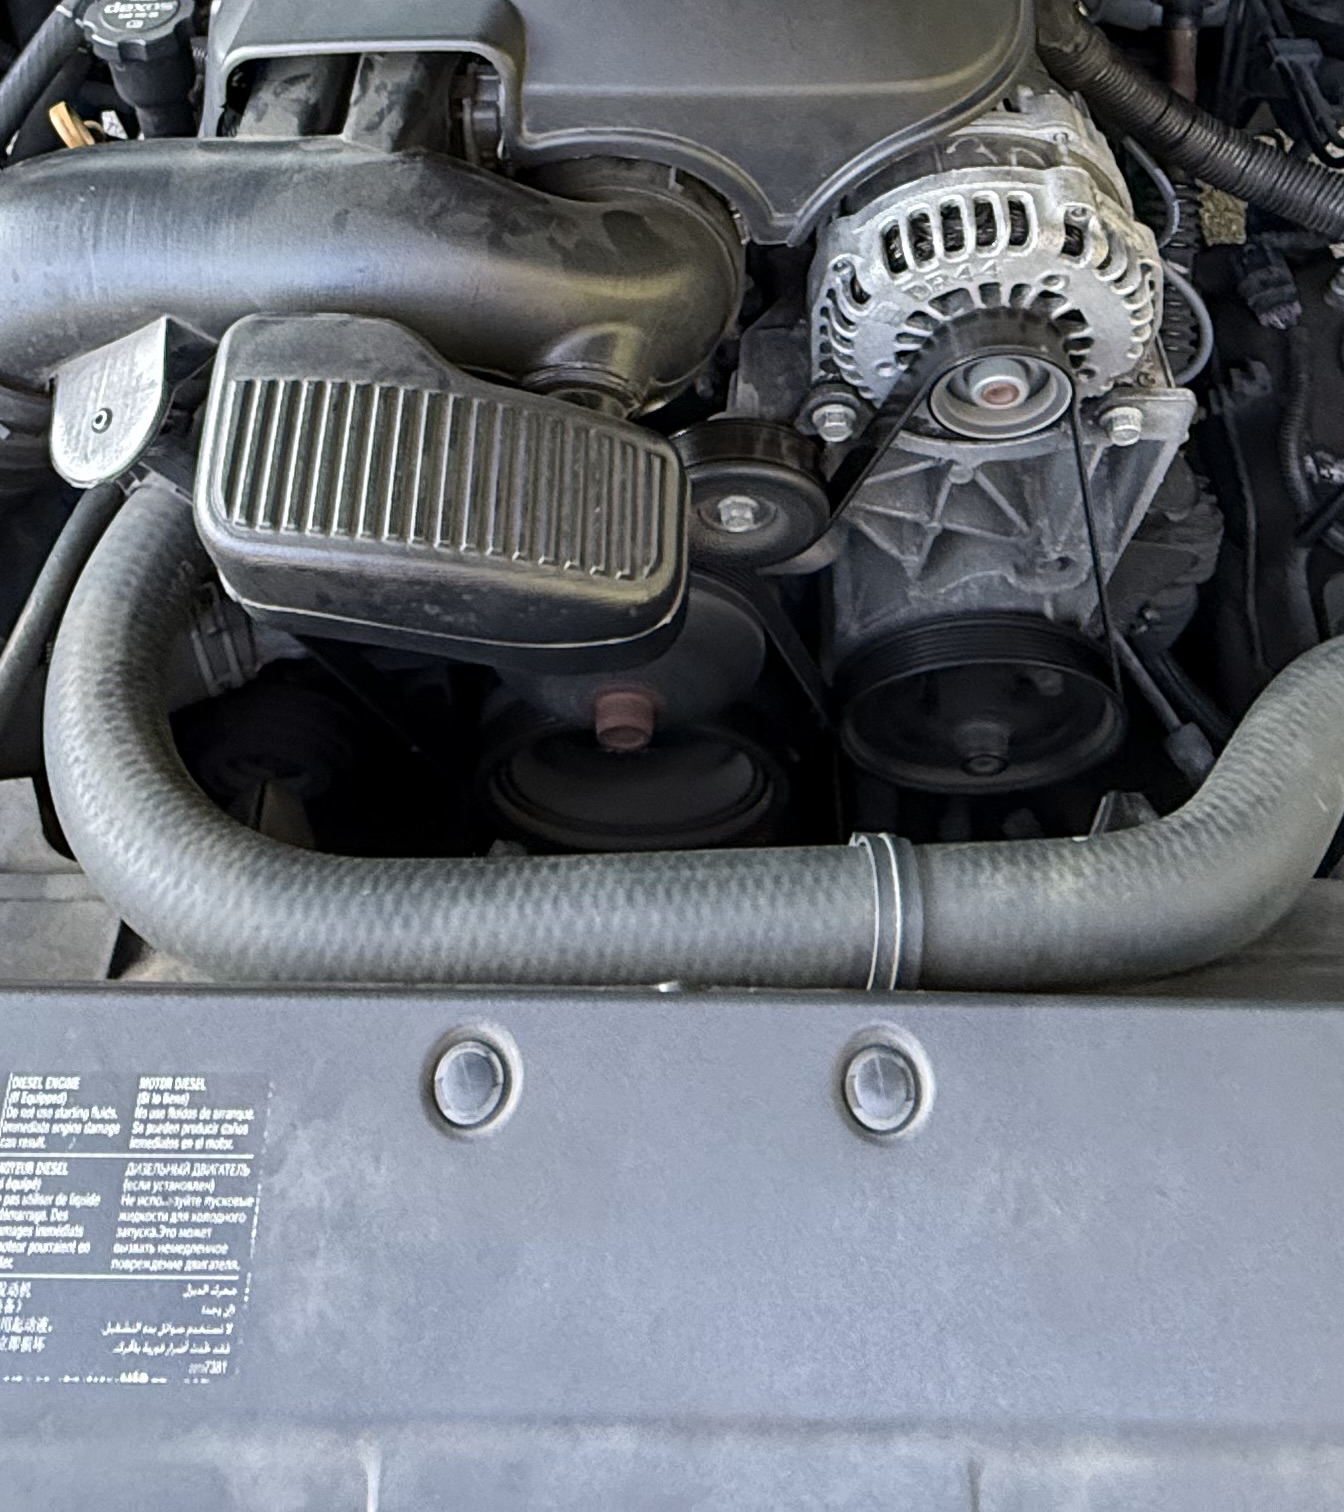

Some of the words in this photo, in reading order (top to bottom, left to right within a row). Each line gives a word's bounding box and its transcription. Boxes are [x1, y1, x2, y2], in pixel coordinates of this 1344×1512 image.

[12, 1076, 44, 1090] DIESEL
[45, 1076, 81, 1090] ENGINE
[139, 1077, 174, 1091] MOTOR
[174, 1077, 206, 1091] DIESEL
[35, 1161, 69, 1176] DIESEL
[191, 1162, 251, 1177] ДВИГАТЕЛЬ
